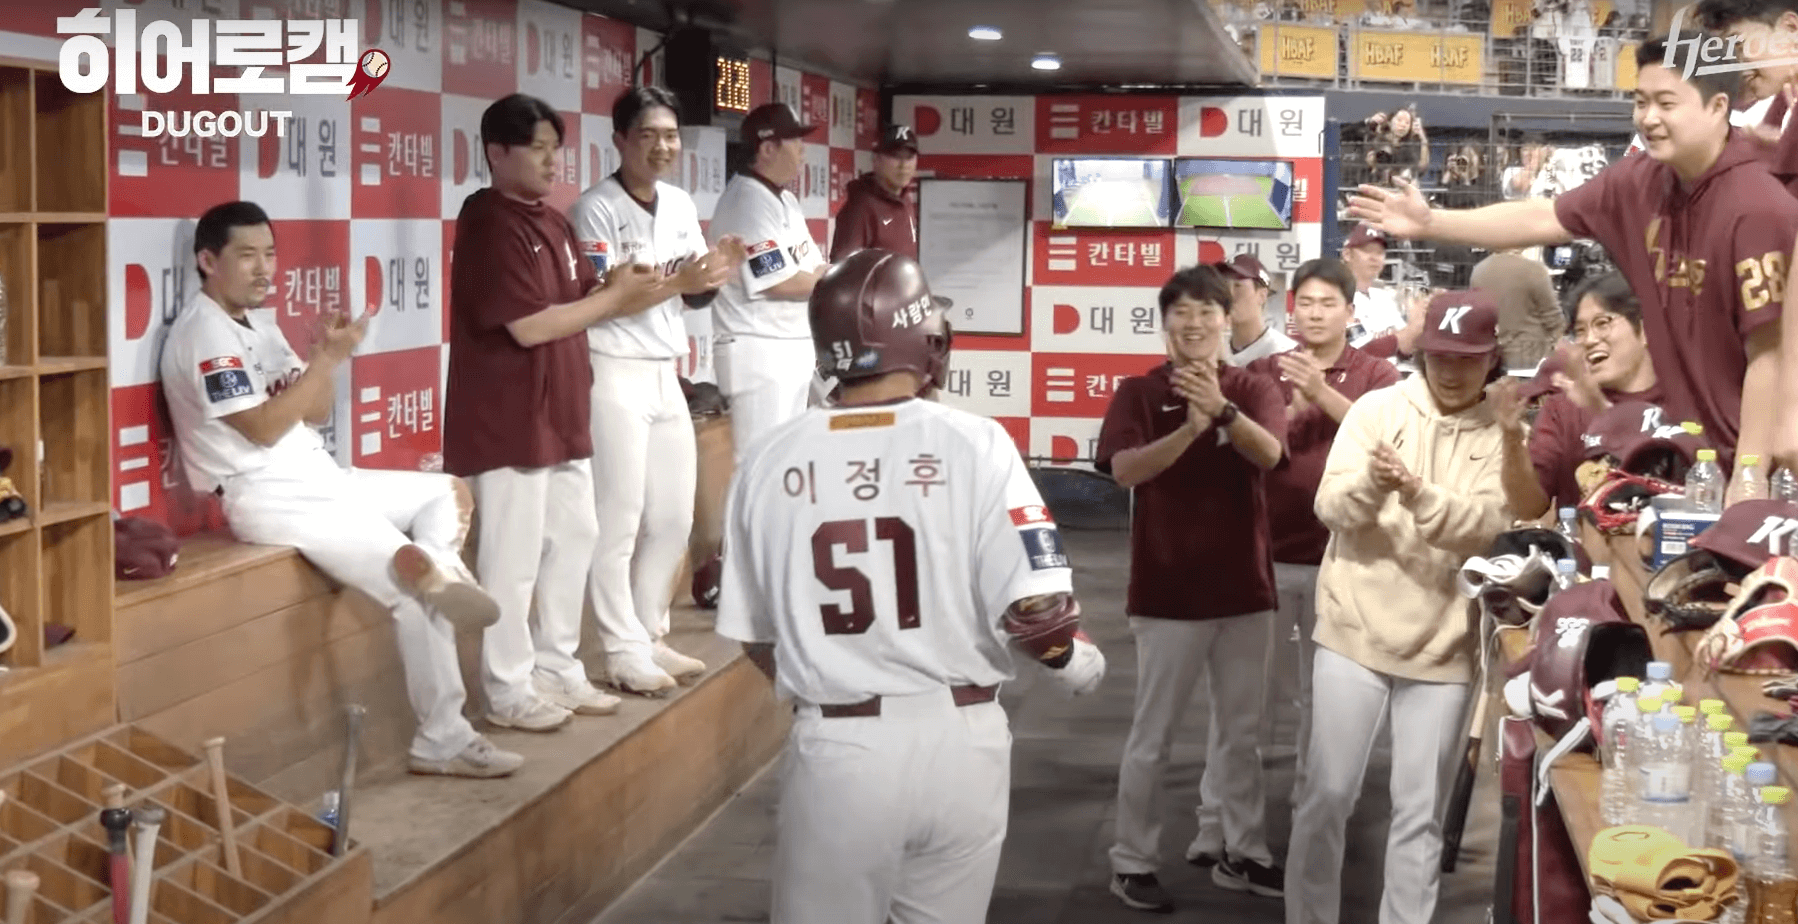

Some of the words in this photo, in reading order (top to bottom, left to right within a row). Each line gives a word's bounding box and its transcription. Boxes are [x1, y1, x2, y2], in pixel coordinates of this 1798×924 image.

[1282, 37, 1315, 61] HBAF
[1365, 43, 1403, 66] HBAF
[951, 106, 1017, 137] 대원
[1090, 109, 1165, 134] 칸타빌
[1238, 108, 1303, 137] 대원
[289, 115, 336, 178] 대원
[387, 131, 433, 178] 칸타빌
[1087, 242, 1162, 267] 칸타빌
[284, 265, 341, 317] 칸타빌
[389, 256, 431, 312] 대원
[1735, 251, 1786, 312] 28
[1090, 305, 1155, 335] 대원
[1438, 306, 1474, 335] K
[832, 340, 853, 360] 51
[947, 369, 1012, 398] 대원
[386, 387, 434, 439] 칸타빌
[783, 453, 947, 504] 이정후
[811, 516, 922, 636] 51
